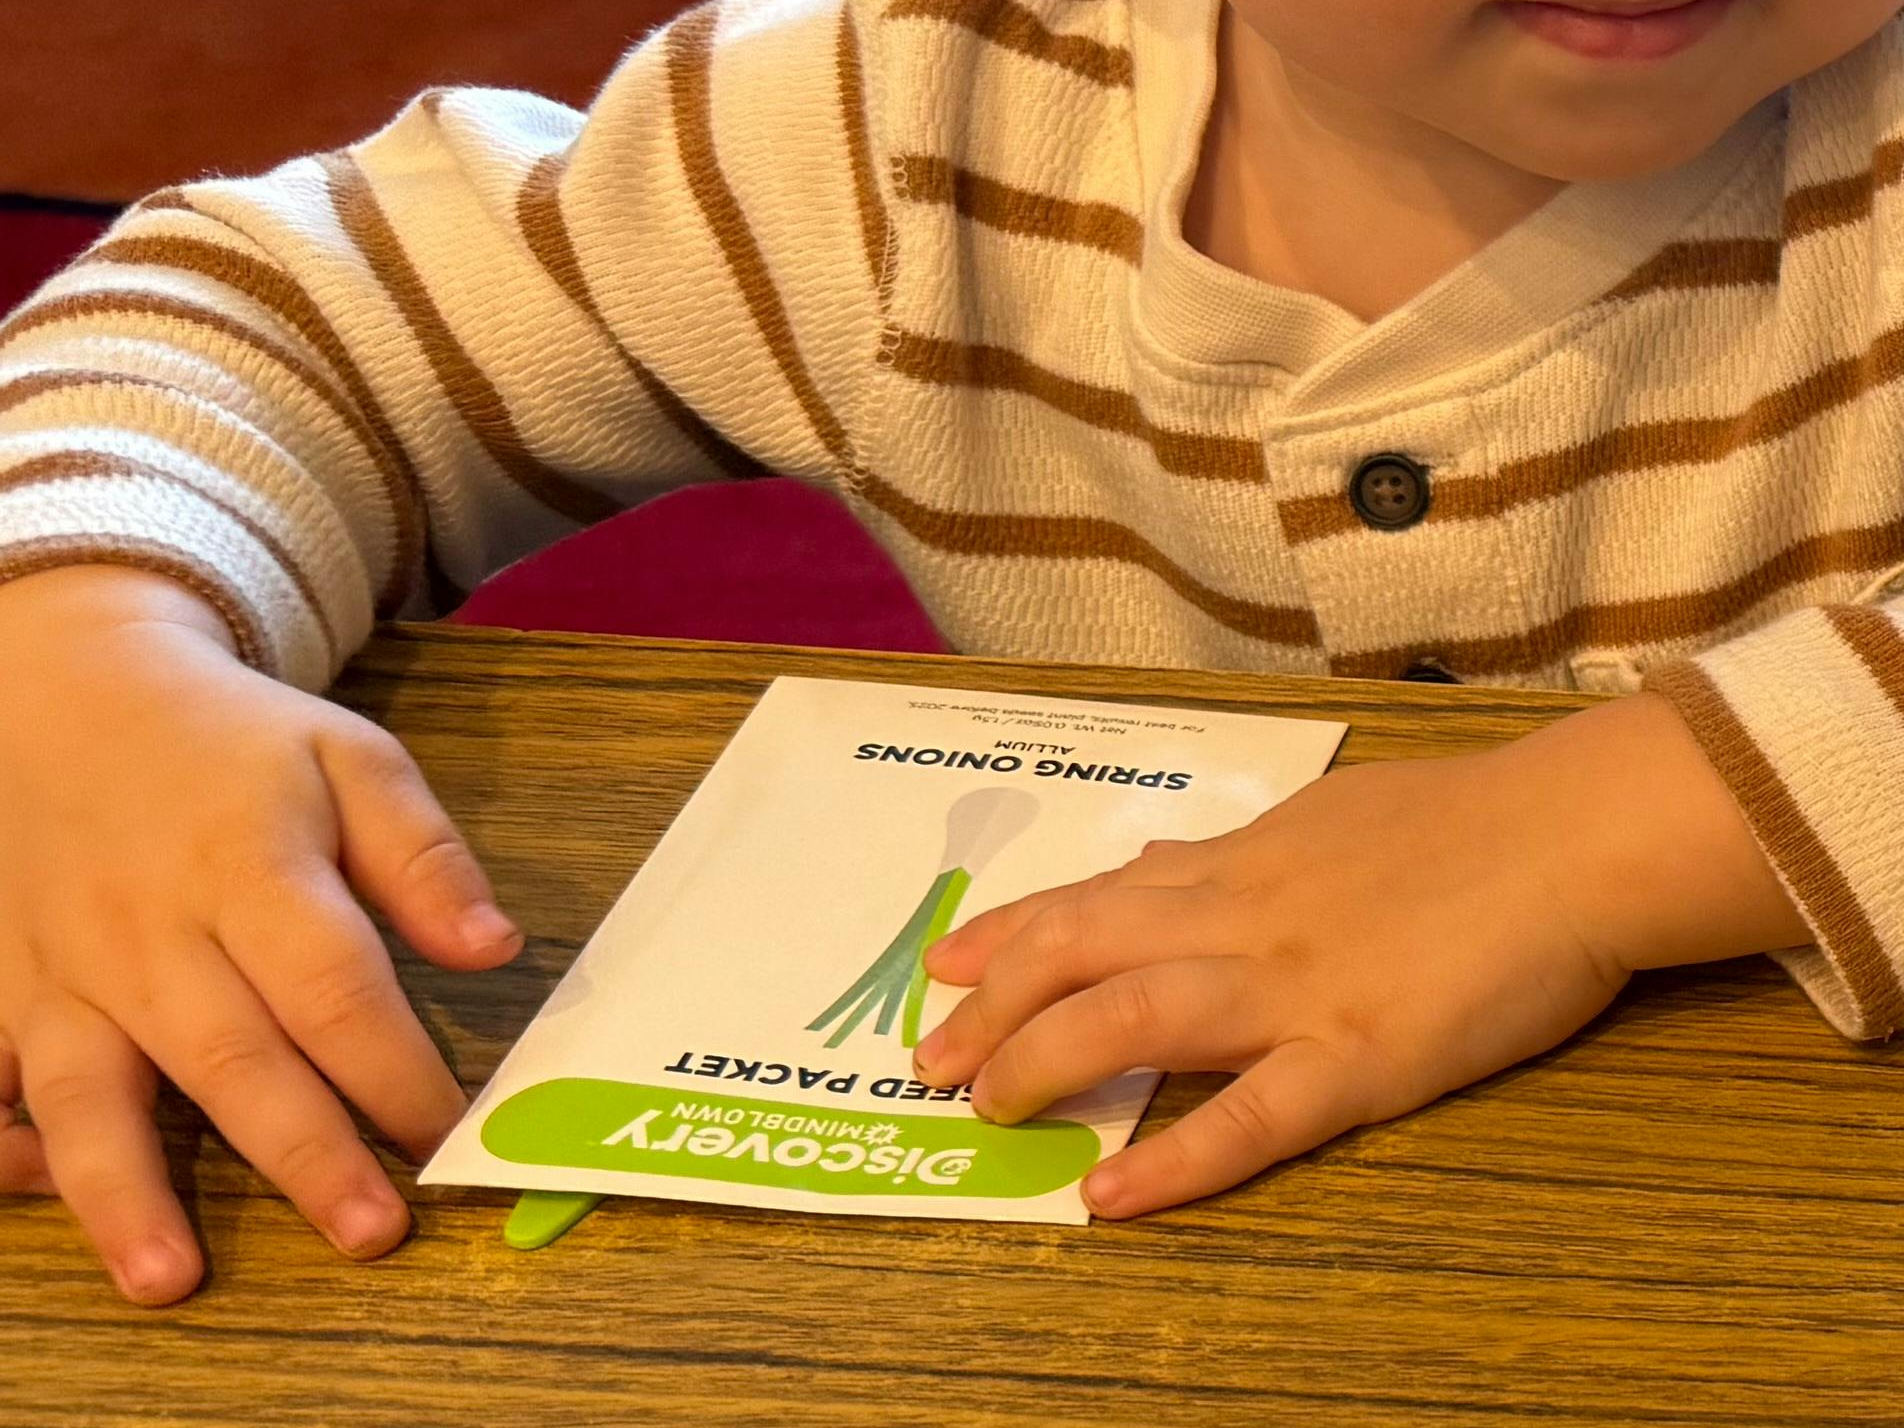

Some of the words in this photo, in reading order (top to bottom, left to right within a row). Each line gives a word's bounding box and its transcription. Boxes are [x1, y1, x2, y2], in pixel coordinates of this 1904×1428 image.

[853, 743, 1022, 773] ONIONS
[994, 739, 1076, 756] ALLIUM
[1032, 759, 1193, 791] SPRING
[664, 1052, 860, 1093] PACKET
[602, 1108, 978, 1186] Discovery
